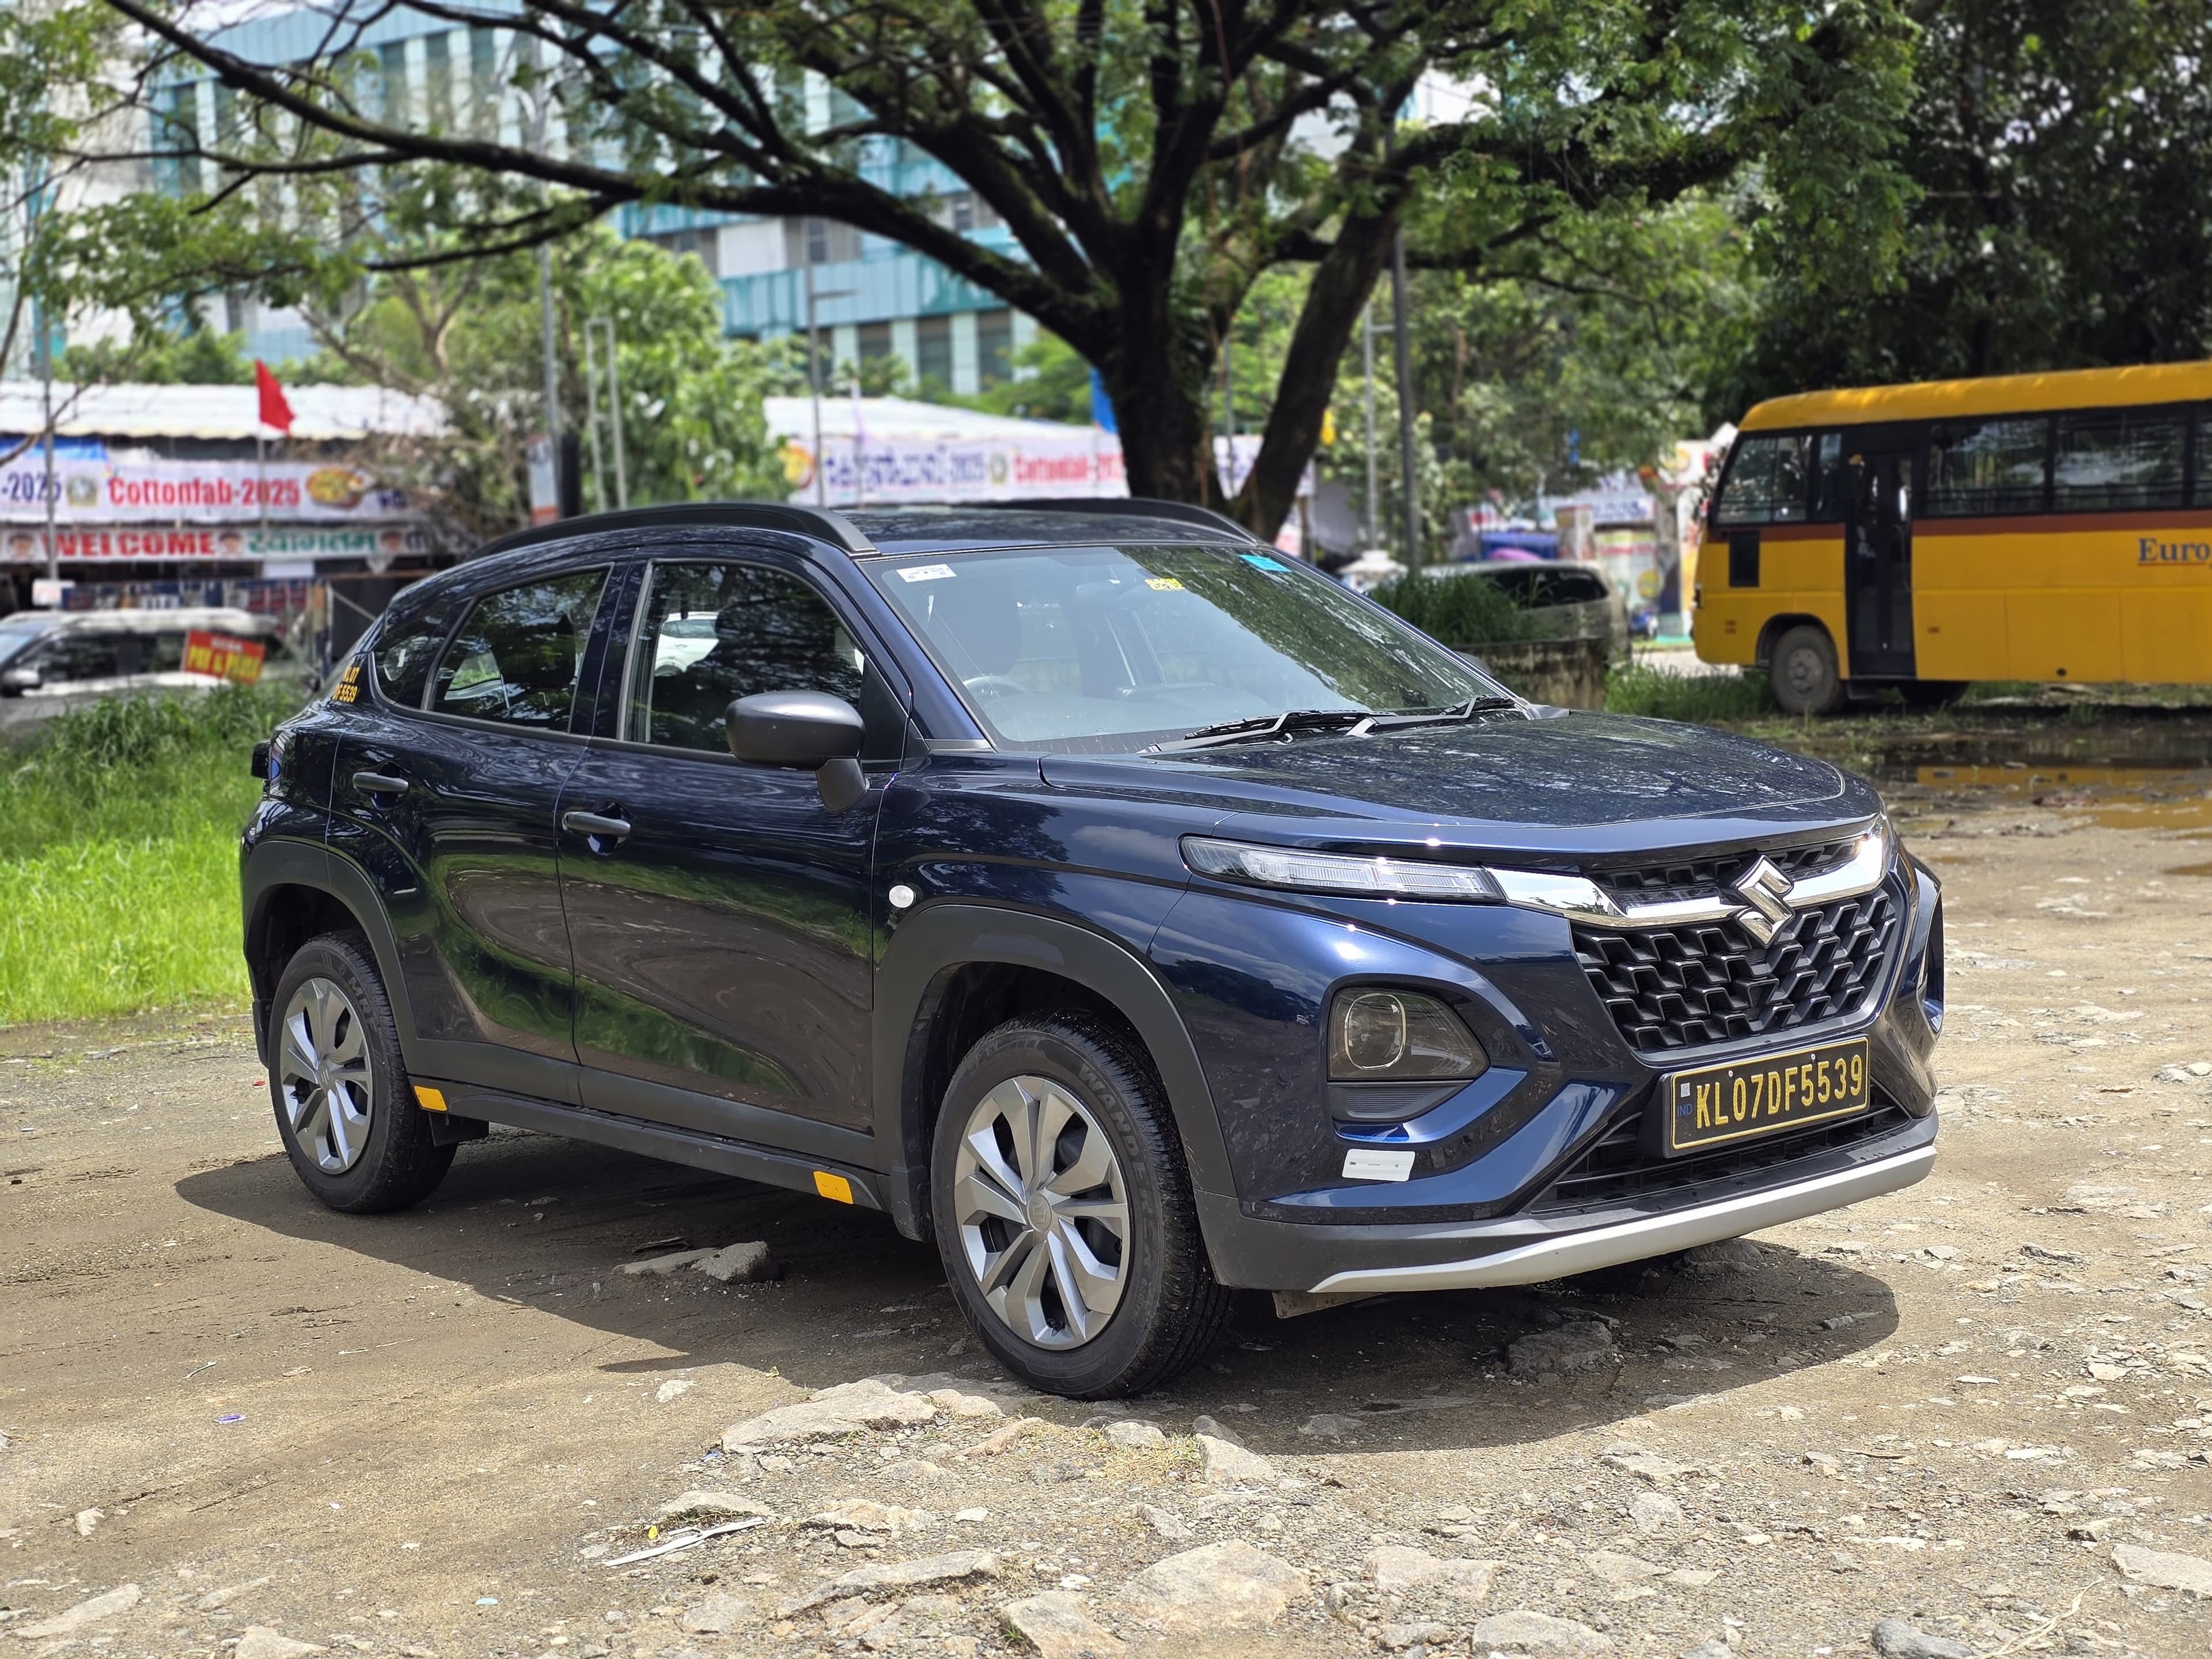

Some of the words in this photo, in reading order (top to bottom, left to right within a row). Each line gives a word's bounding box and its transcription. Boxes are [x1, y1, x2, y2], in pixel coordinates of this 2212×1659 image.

[40, 531, 215, 556] WELCOME
[1696, 1054, 1863, 1130] KL07DF5539
[1677, 1103, 1692, 1118] IND
